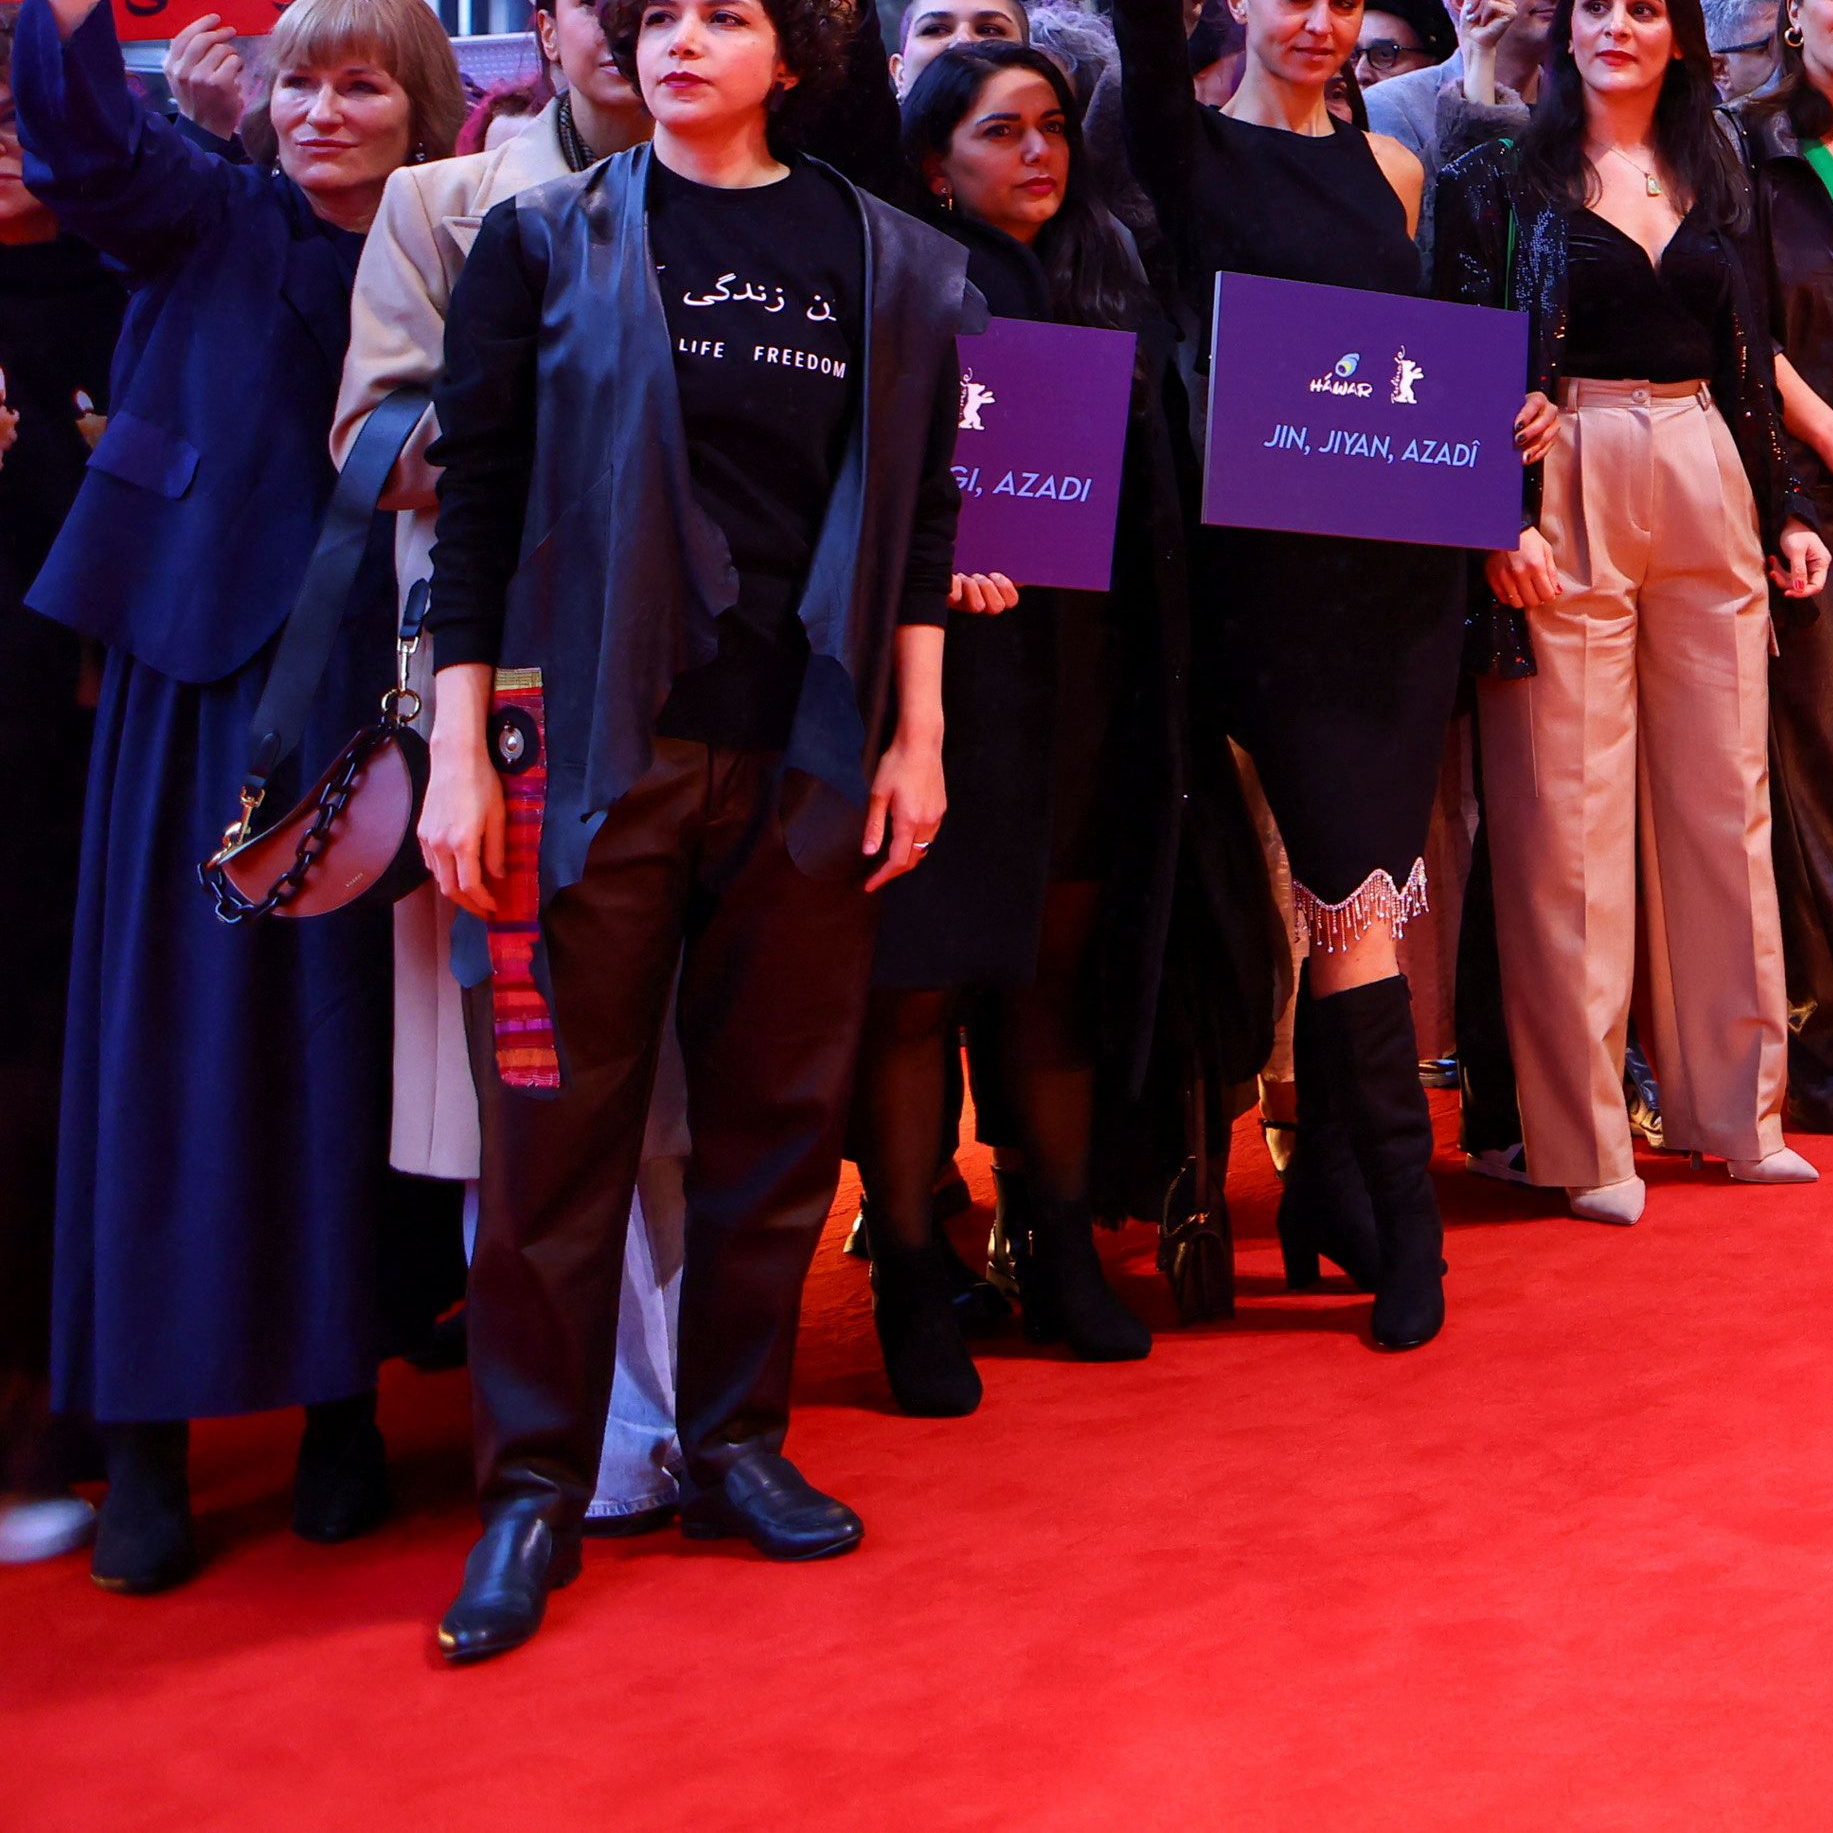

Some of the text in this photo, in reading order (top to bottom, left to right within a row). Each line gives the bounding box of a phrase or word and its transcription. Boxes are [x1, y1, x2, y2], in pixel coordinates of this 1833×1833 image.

[683, 273, 785, 312] زندگی
[679, 338, 847, 379] LIFE FREEDOM
[1263, 424, 1481, 468] JIN, JIYAN, AZADÎ
[992, 470, 1092, 503] AZADI
